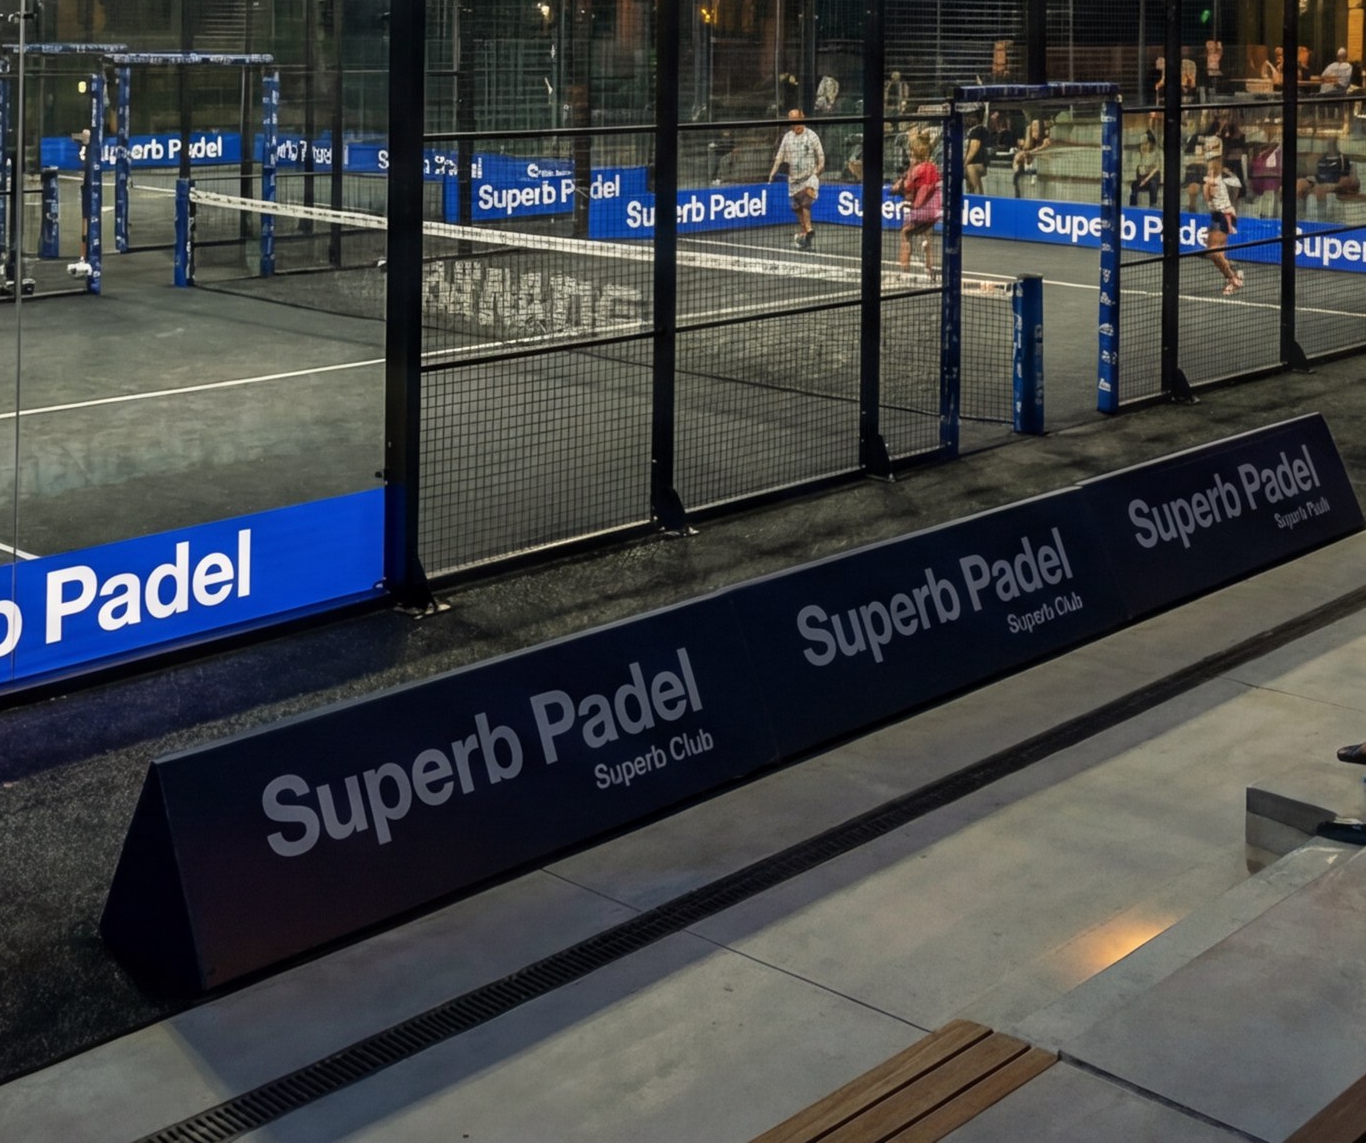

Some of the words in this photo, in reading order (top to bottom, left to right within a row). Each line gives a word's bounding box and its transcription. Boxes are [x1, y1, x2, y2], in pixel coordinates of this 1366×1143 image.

[561, 174, 621, 204] Pdel
[626, 195, 705, 228] Suerb
[710, 189, 768, 220] Padel
[1037, 207, 1137, 243] Supeb
[1128, 473, 1242, 549] Superb
[1237, 444, 1322, 510] Padel
[44, 529, 252, 644] Padel
[796, 567, 962, 668] Superb
[958, 527, 1074, 612] Padel
[261, 712, 523, 858] Superb
[529, 647, 704, 765] Padel
[593, 745, 668, 790] Superb
[669, 729, 715, 762] Club
